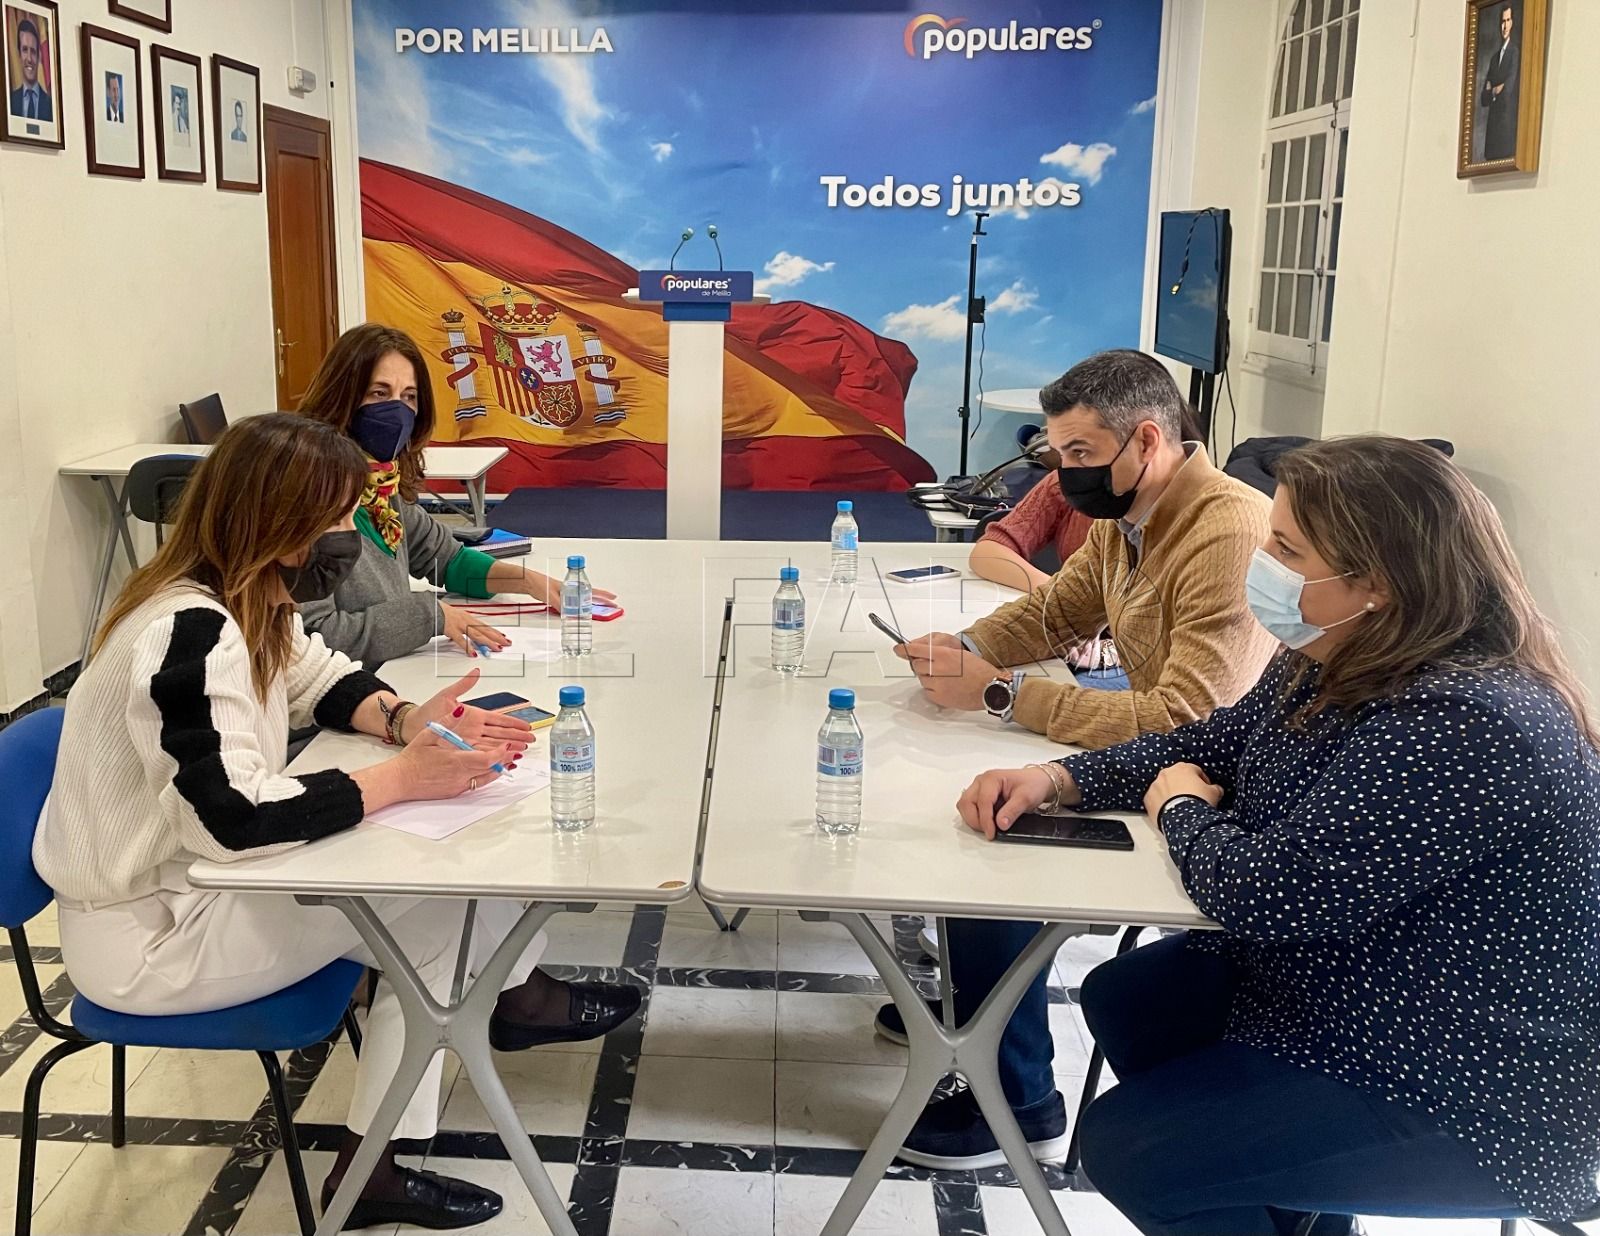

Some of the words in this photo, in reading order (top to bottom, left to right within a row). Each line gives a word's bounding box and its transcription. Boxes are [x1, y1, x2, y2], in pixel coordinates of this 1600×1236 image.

[395, 28, 464, 53] POR
[472, 28, 614, 53] MELILLA
[820, 175, 941, 208] Todos
[946, 175, 1081, 217] juntos
